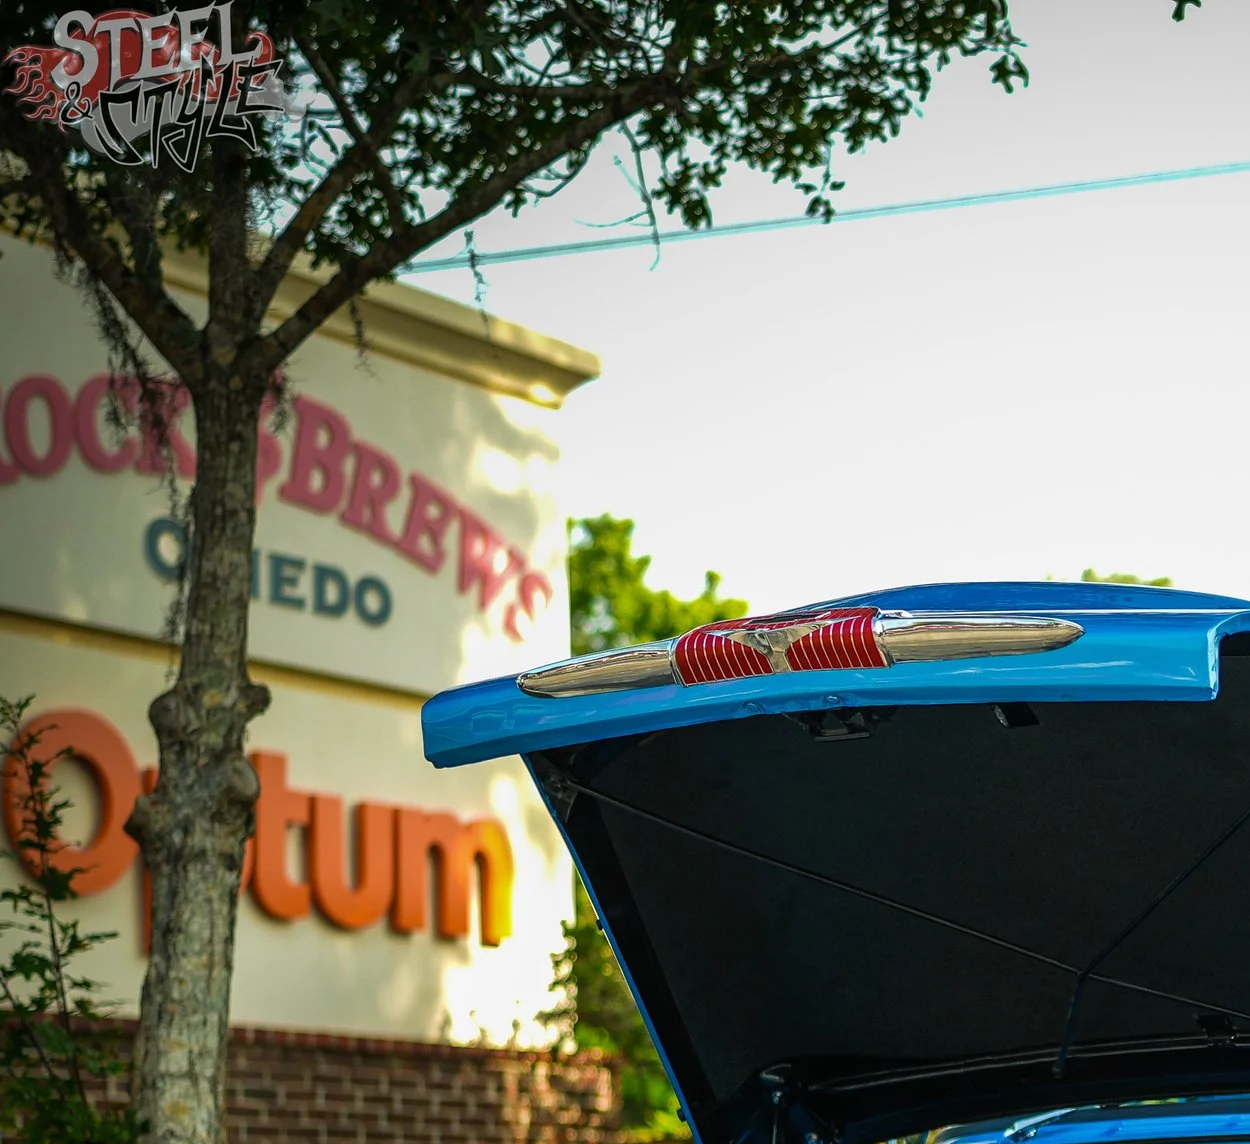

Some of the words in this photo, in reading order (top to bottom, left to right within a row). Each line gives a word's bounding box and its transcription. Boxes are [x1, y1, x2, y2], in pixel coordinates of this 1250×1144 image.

[0, 373, 197, 487] OCK
[279, 391, 554, 642] BREWS
[143, 516, 393, 630] OIEDO
